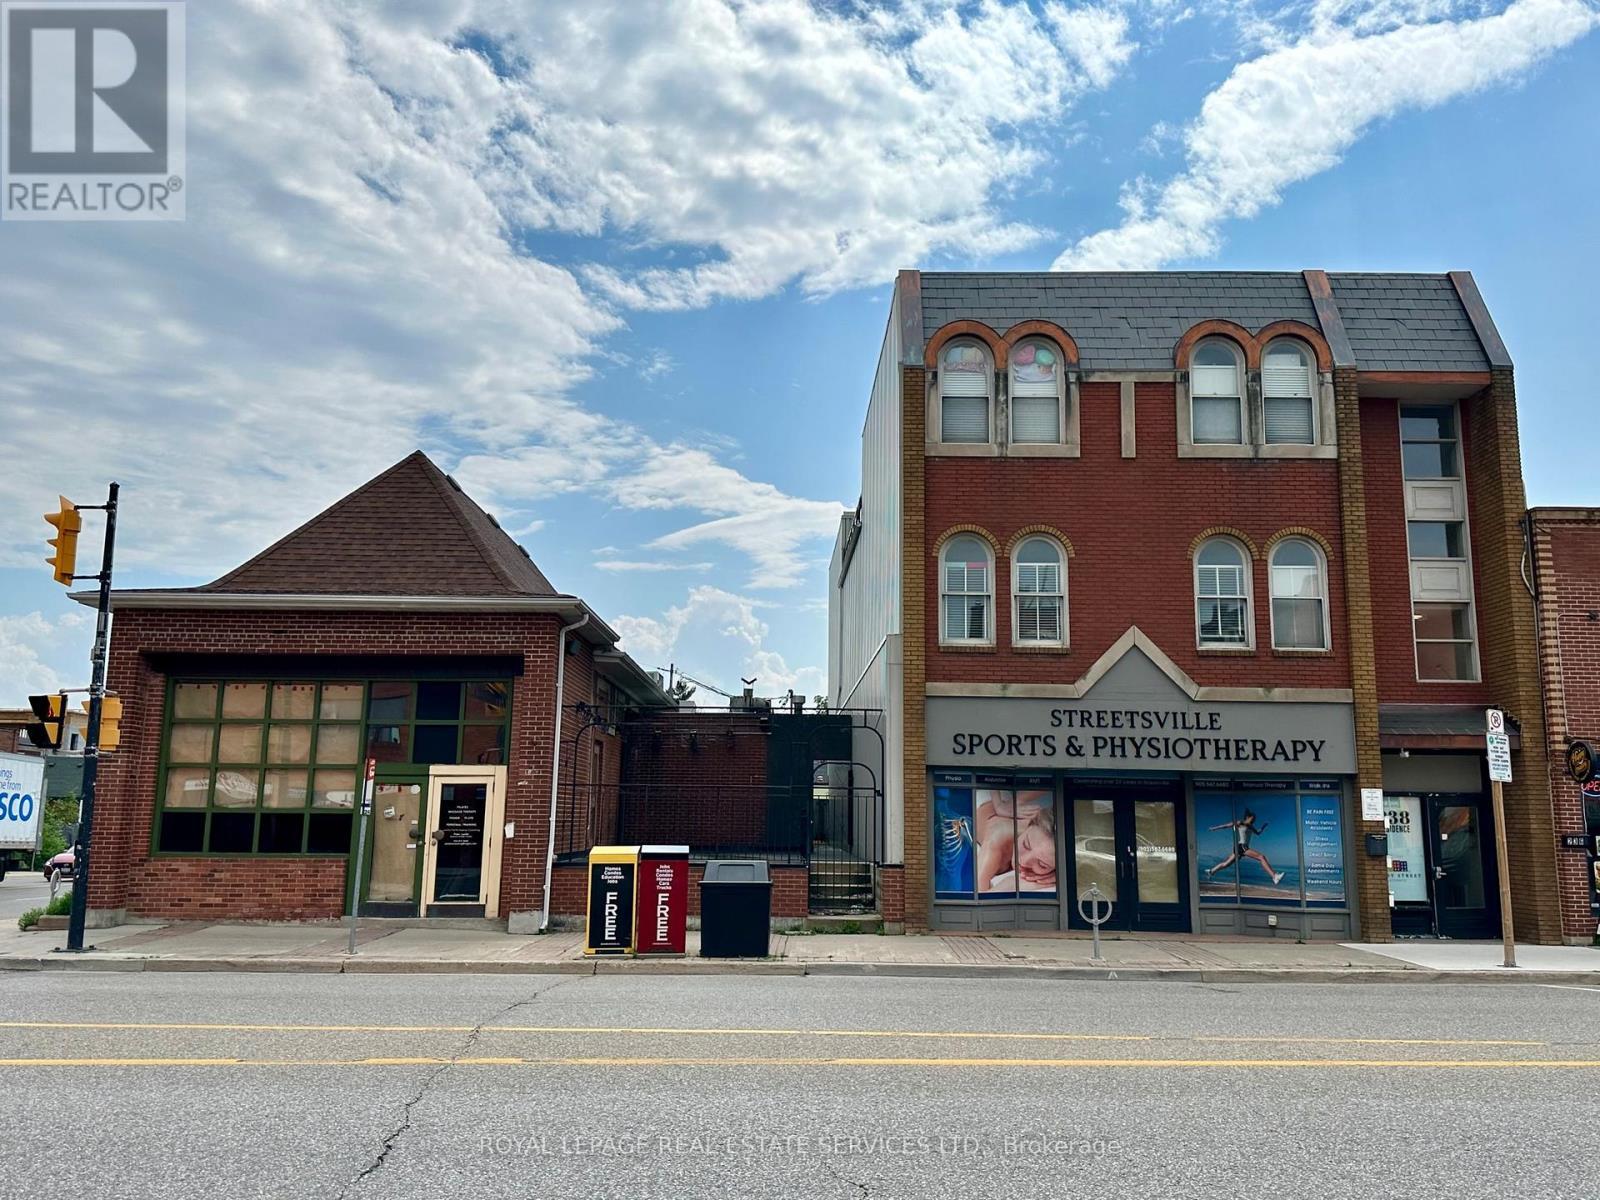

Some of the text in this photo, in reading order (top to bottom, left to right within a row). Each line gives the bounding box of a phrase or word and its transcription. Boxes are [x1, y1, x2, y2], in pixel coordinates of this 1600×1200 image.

[1050, 709, 1222, 730] STREETSVILLE
[952, 733, 1327, 761] SPORTS & PHYSIOTHERAPY
[6, 779, 22, 791] from
[0, 792, 33, 822] SCO
[1384, 810, 1410, 825] 38
[604, 891, 618, 941] FREE
[656, 892, 670, 942] FREE
